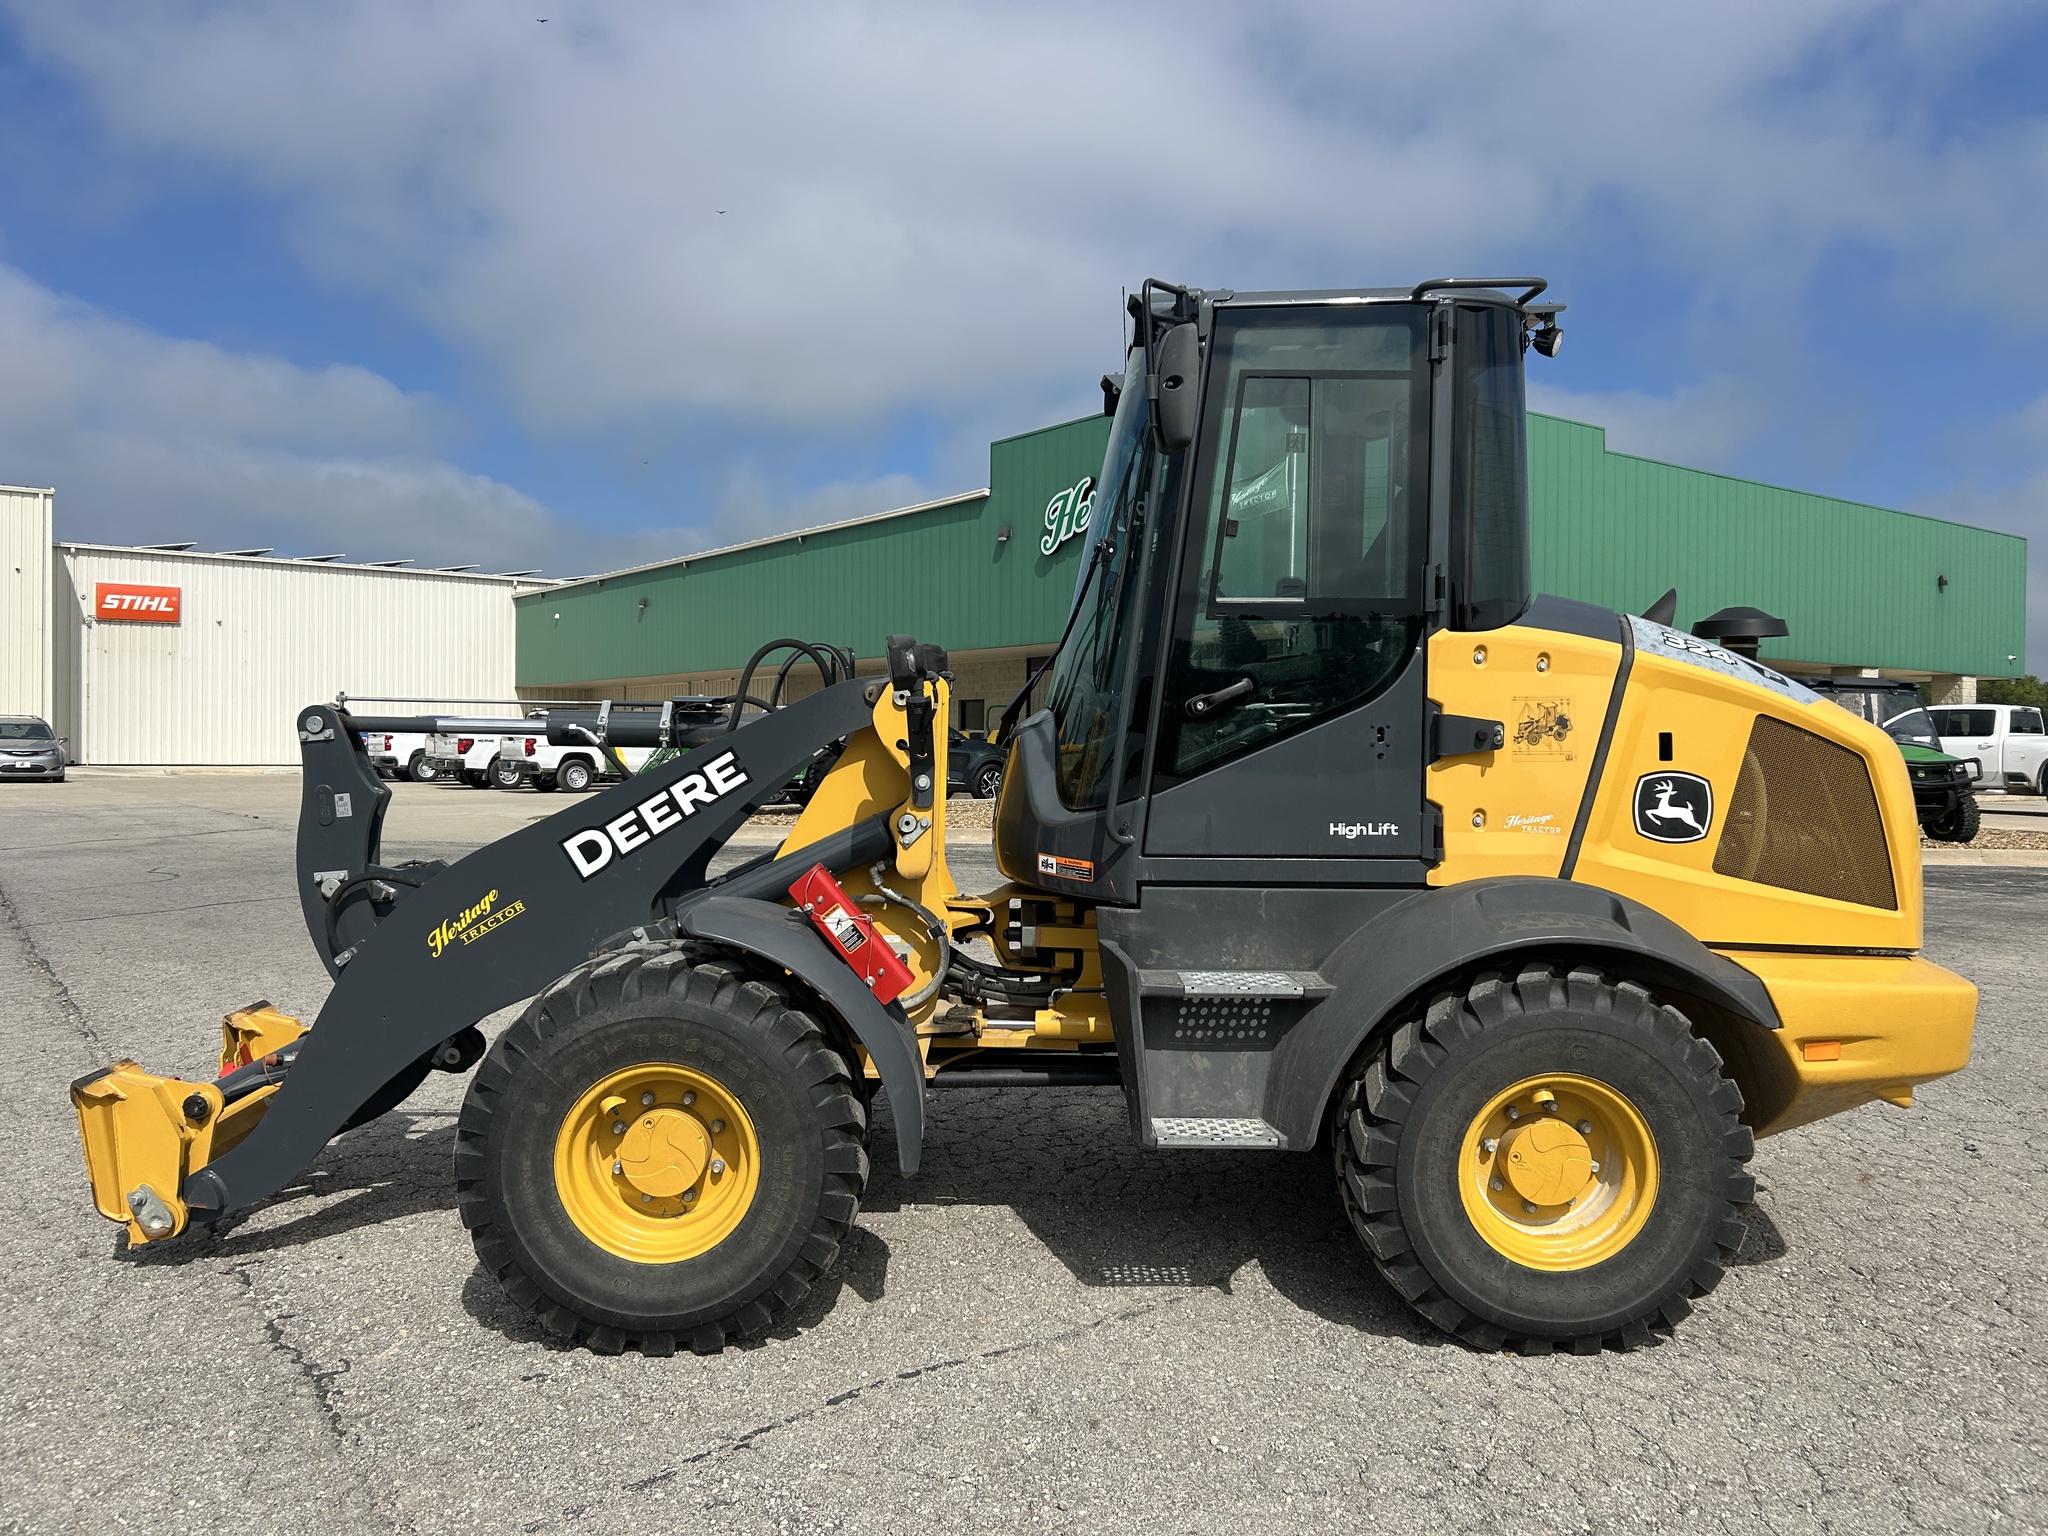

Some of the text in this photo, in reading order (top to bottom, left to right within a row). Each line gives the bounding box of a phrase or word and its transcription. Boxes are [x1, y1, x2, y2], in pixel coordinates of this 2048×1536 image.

[1240, 489, 1277, 508] TRACTOR
[101, 594, 174, 612] STIHL
[562, 750, 750, 878] DEERE
[1503, 813, 1553, 829] Heritage
[1521, 826, 1561, 834] TRACTOR
[427, 889, 499, 958] Heritage
[460, 901, 525, 944] TRACTOR
